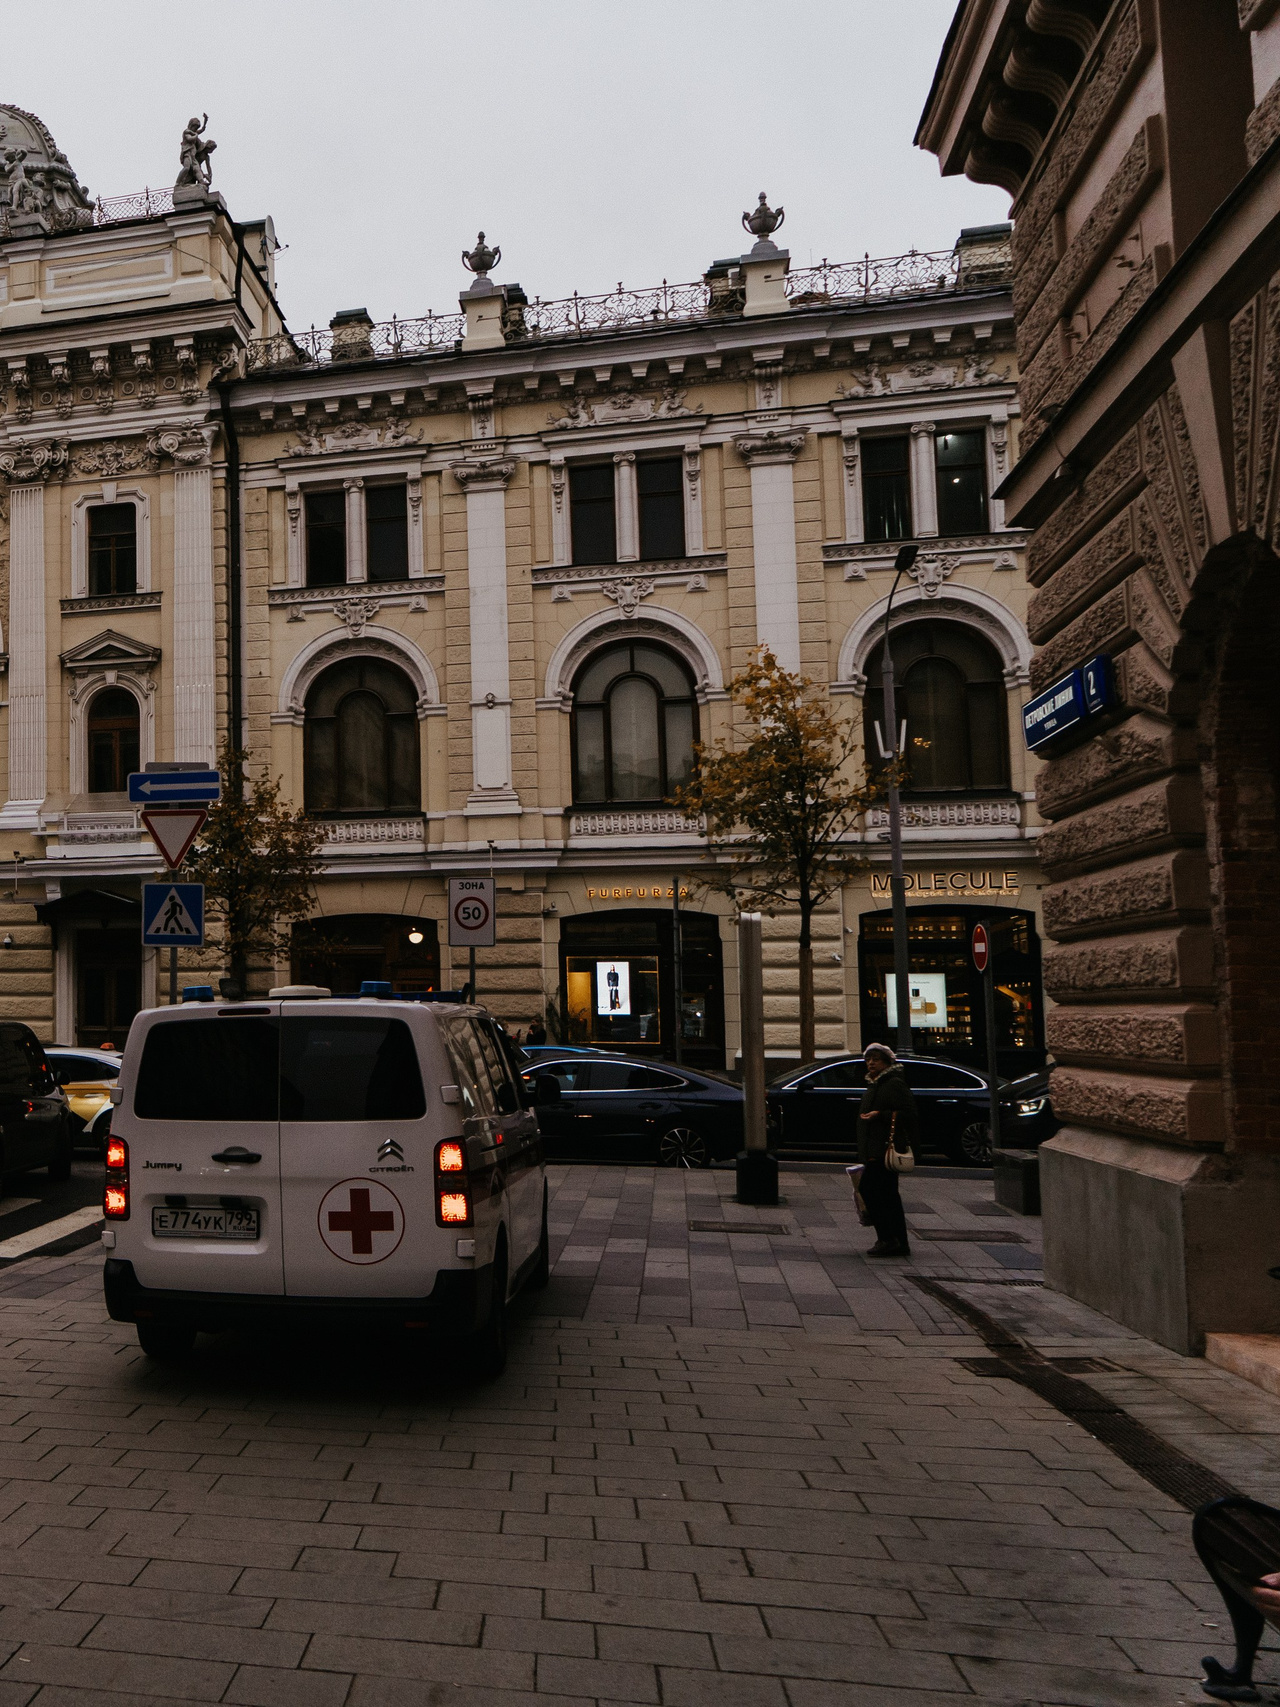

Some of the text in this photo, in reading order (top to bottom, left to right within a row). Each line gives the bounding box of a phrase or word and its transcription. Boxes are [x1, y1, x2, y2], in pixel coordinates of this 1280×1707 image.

[1087, 671, 1096, 696] 2
[459, 882, 485, 890] ЗОНА
[871, 871, 1019, 891] MOLECULE
[462, 906, 481, 920] 50
[142, 1160, 182, 1171] Jumpy
[159, 1211, 252, 1230] Е774УК 799
